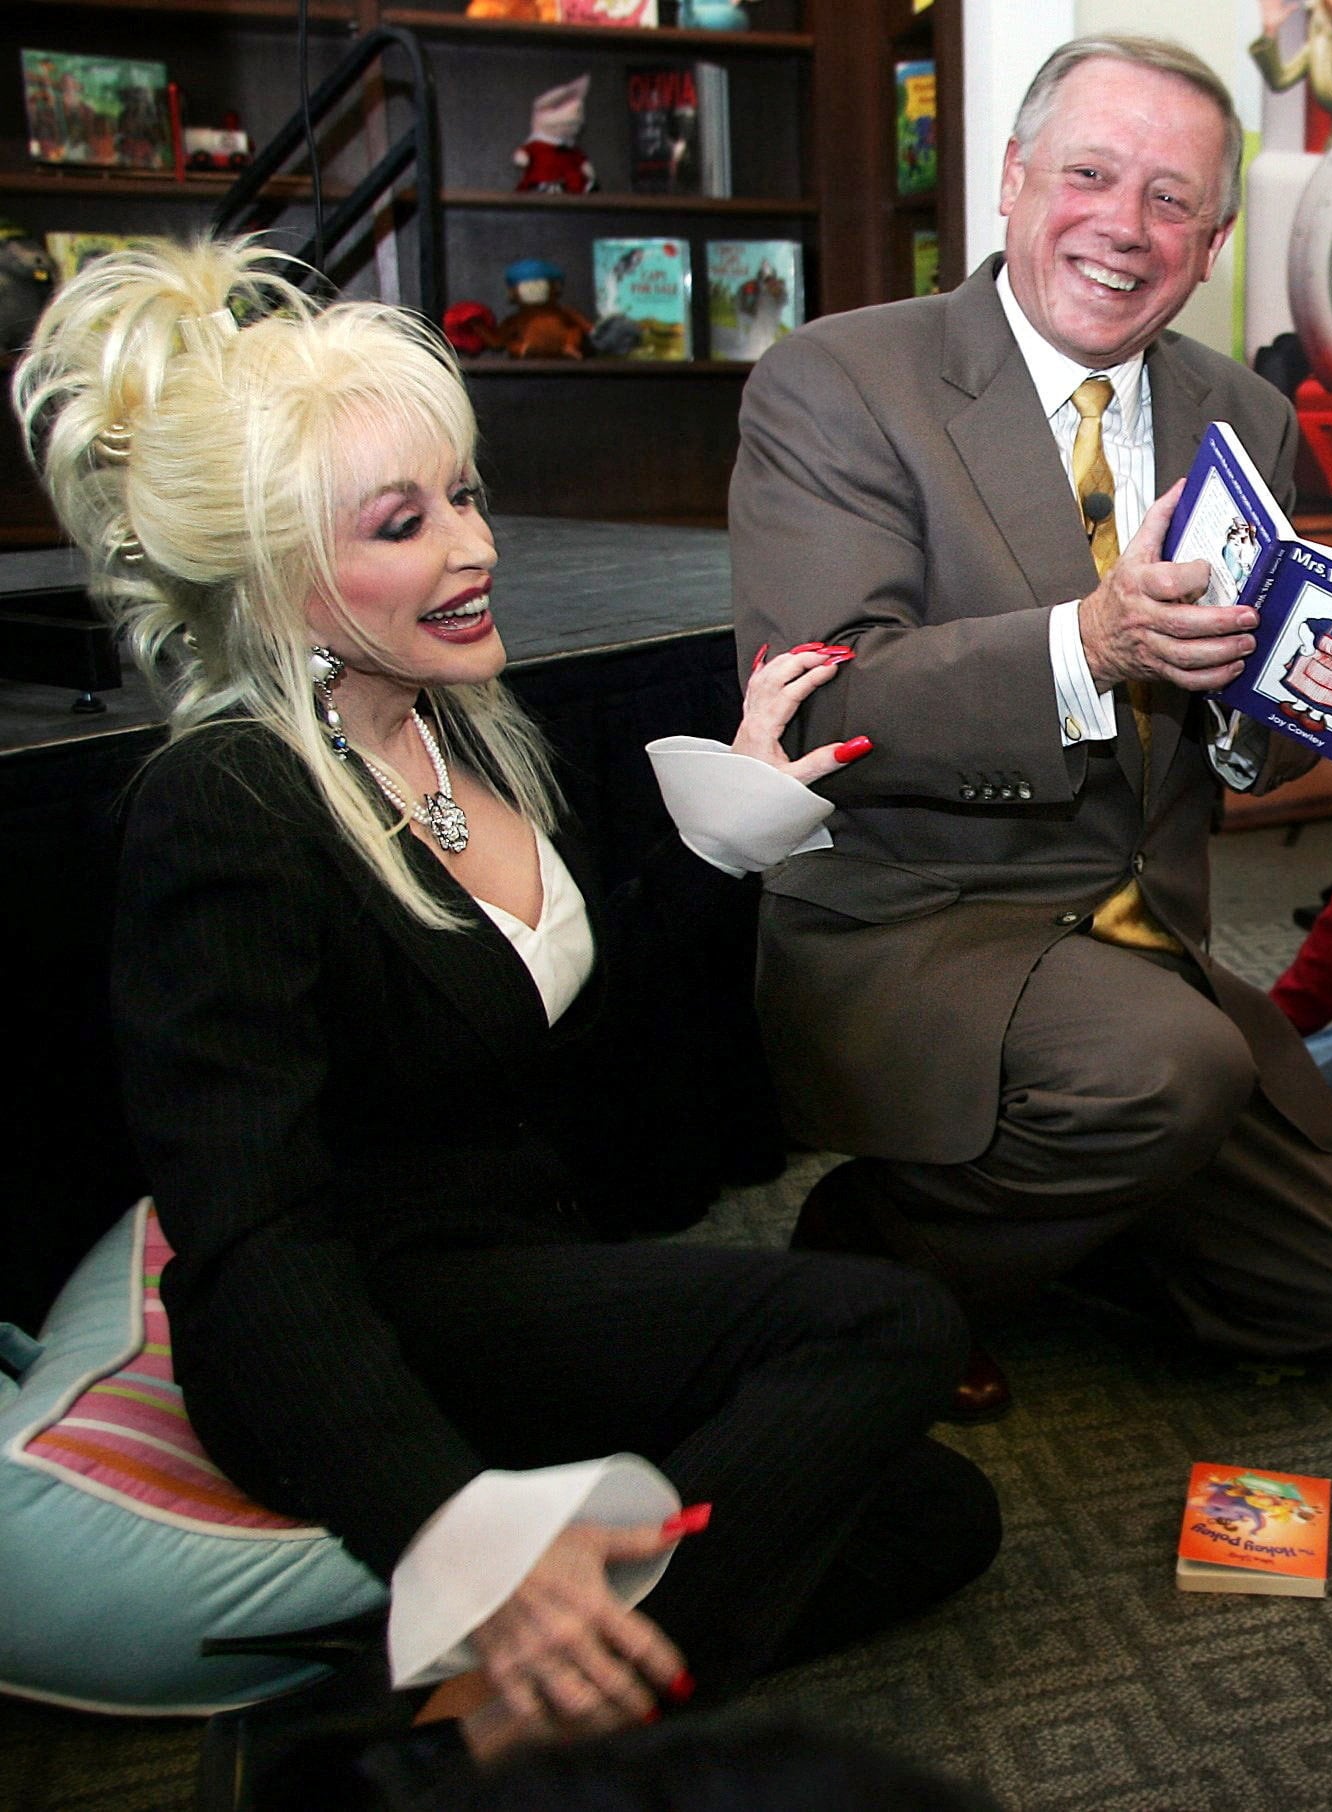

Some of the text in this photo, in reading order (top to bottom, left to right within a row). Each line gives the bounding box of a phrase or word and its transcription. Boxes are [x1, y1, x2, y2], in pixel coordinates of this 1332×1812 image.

[1291, 547, 1327, 579] Mrs.
[1267, 713, 1326, 747] Joy Cowley
[1190, 1522, 1242, 1547] Pokey
[1243, 1540, 1297, 1558] Hokey
